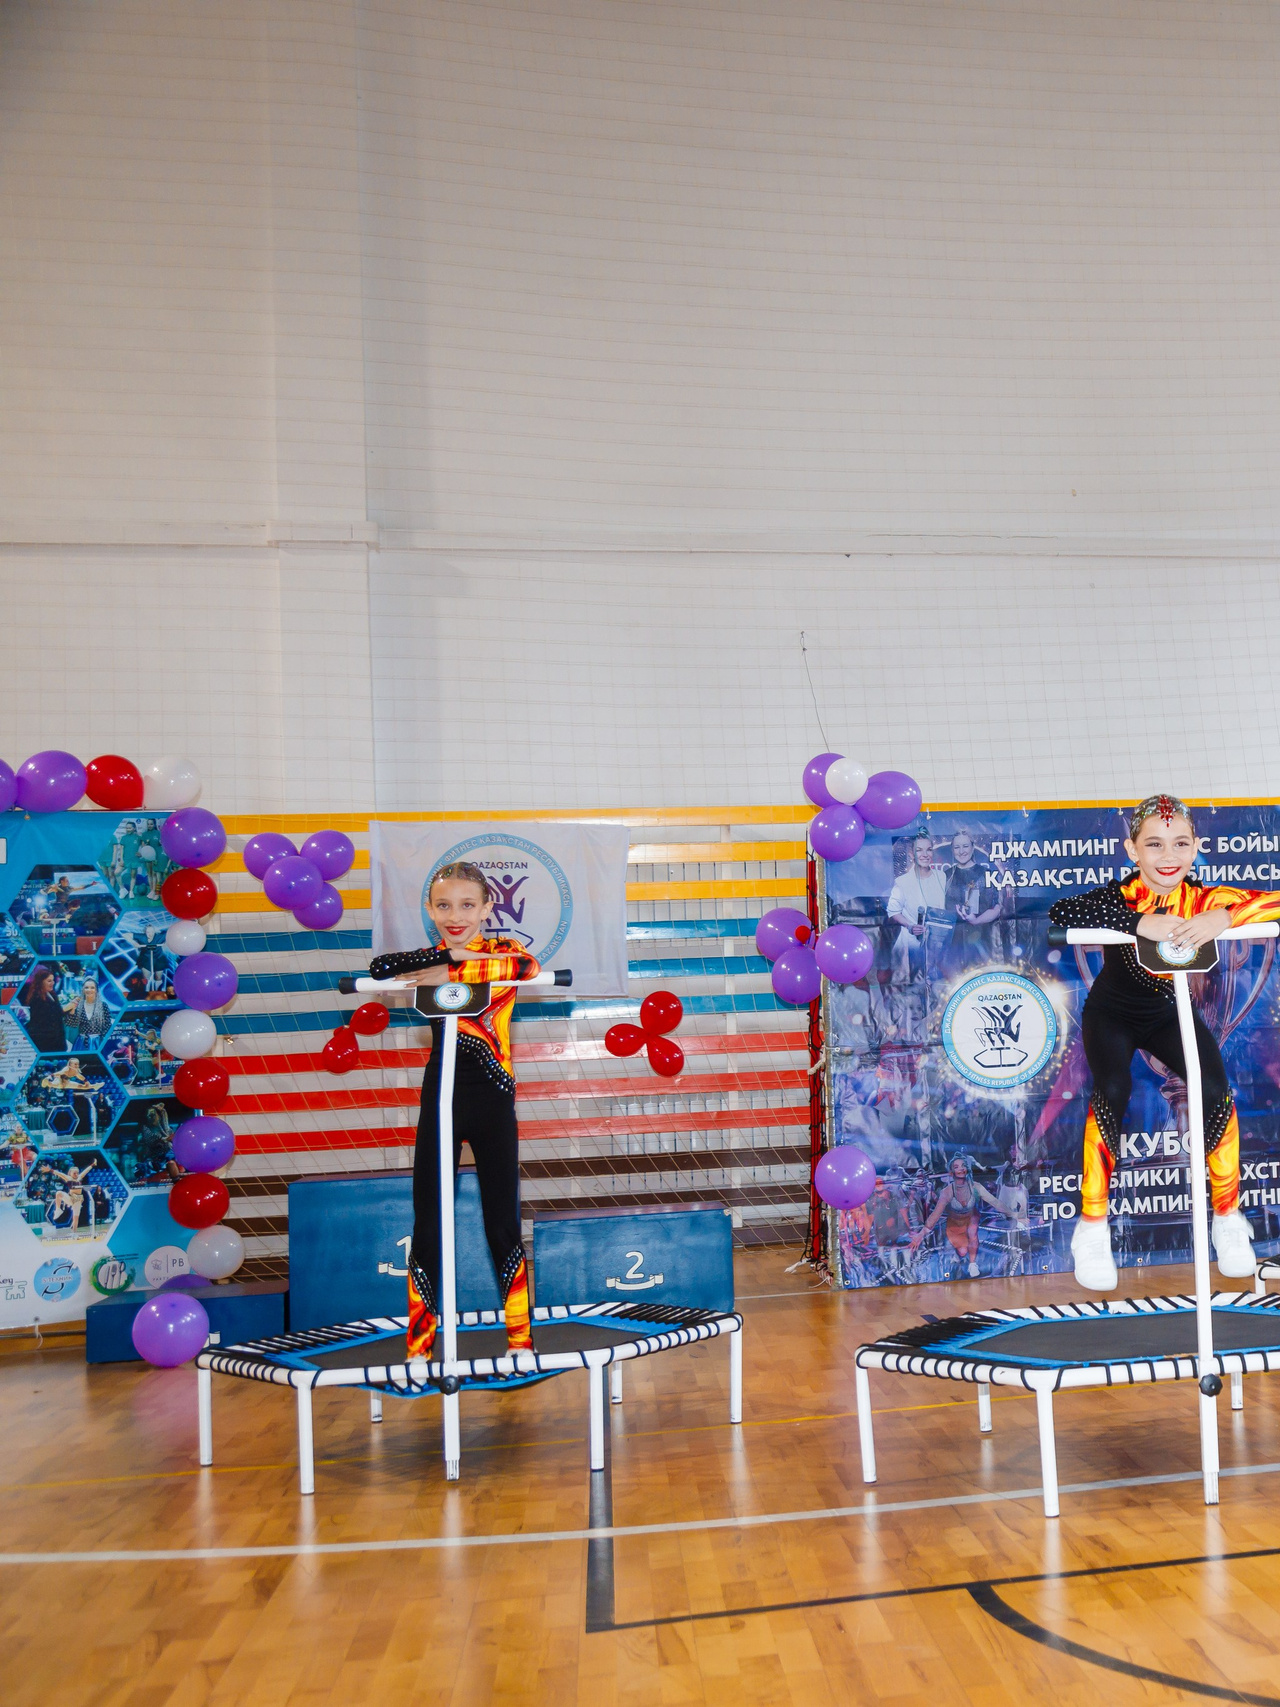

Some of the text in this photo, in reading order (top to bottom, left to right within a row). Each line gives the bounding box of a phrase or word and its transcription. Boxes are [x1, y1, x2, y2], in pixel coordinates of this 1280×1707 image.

[445, 839, 478, 862] ФИТНЕС
[989, 838, 1119, 862] ДЖАМПИНГ
[985, 867, 1114, 890] ҚАЗАҚСТАН
[945, 994, 962, 1034] ДЖАМПИНГ
[961, 978, 986, 996] ФИТНЕС
[978, 993, 1022, 1002] QAZAQSTAN
[949, 1050, 968, 1073] JUMPING
[968, 1070, 992, 1085] FITNESS
[991, 1077, 1019, 1086] REPUBLIC
[1020, 1073, 1029, 1081] OF
[1039, 1168, 1180, 1194] РЕСБЛИКИ
[1043, 1202, 1076, 1220] ПО
[172, 1258, 185, 1267] PB
[397, 1236, 411, 1265] 1
[625, 1251, 644, 1279] 2
